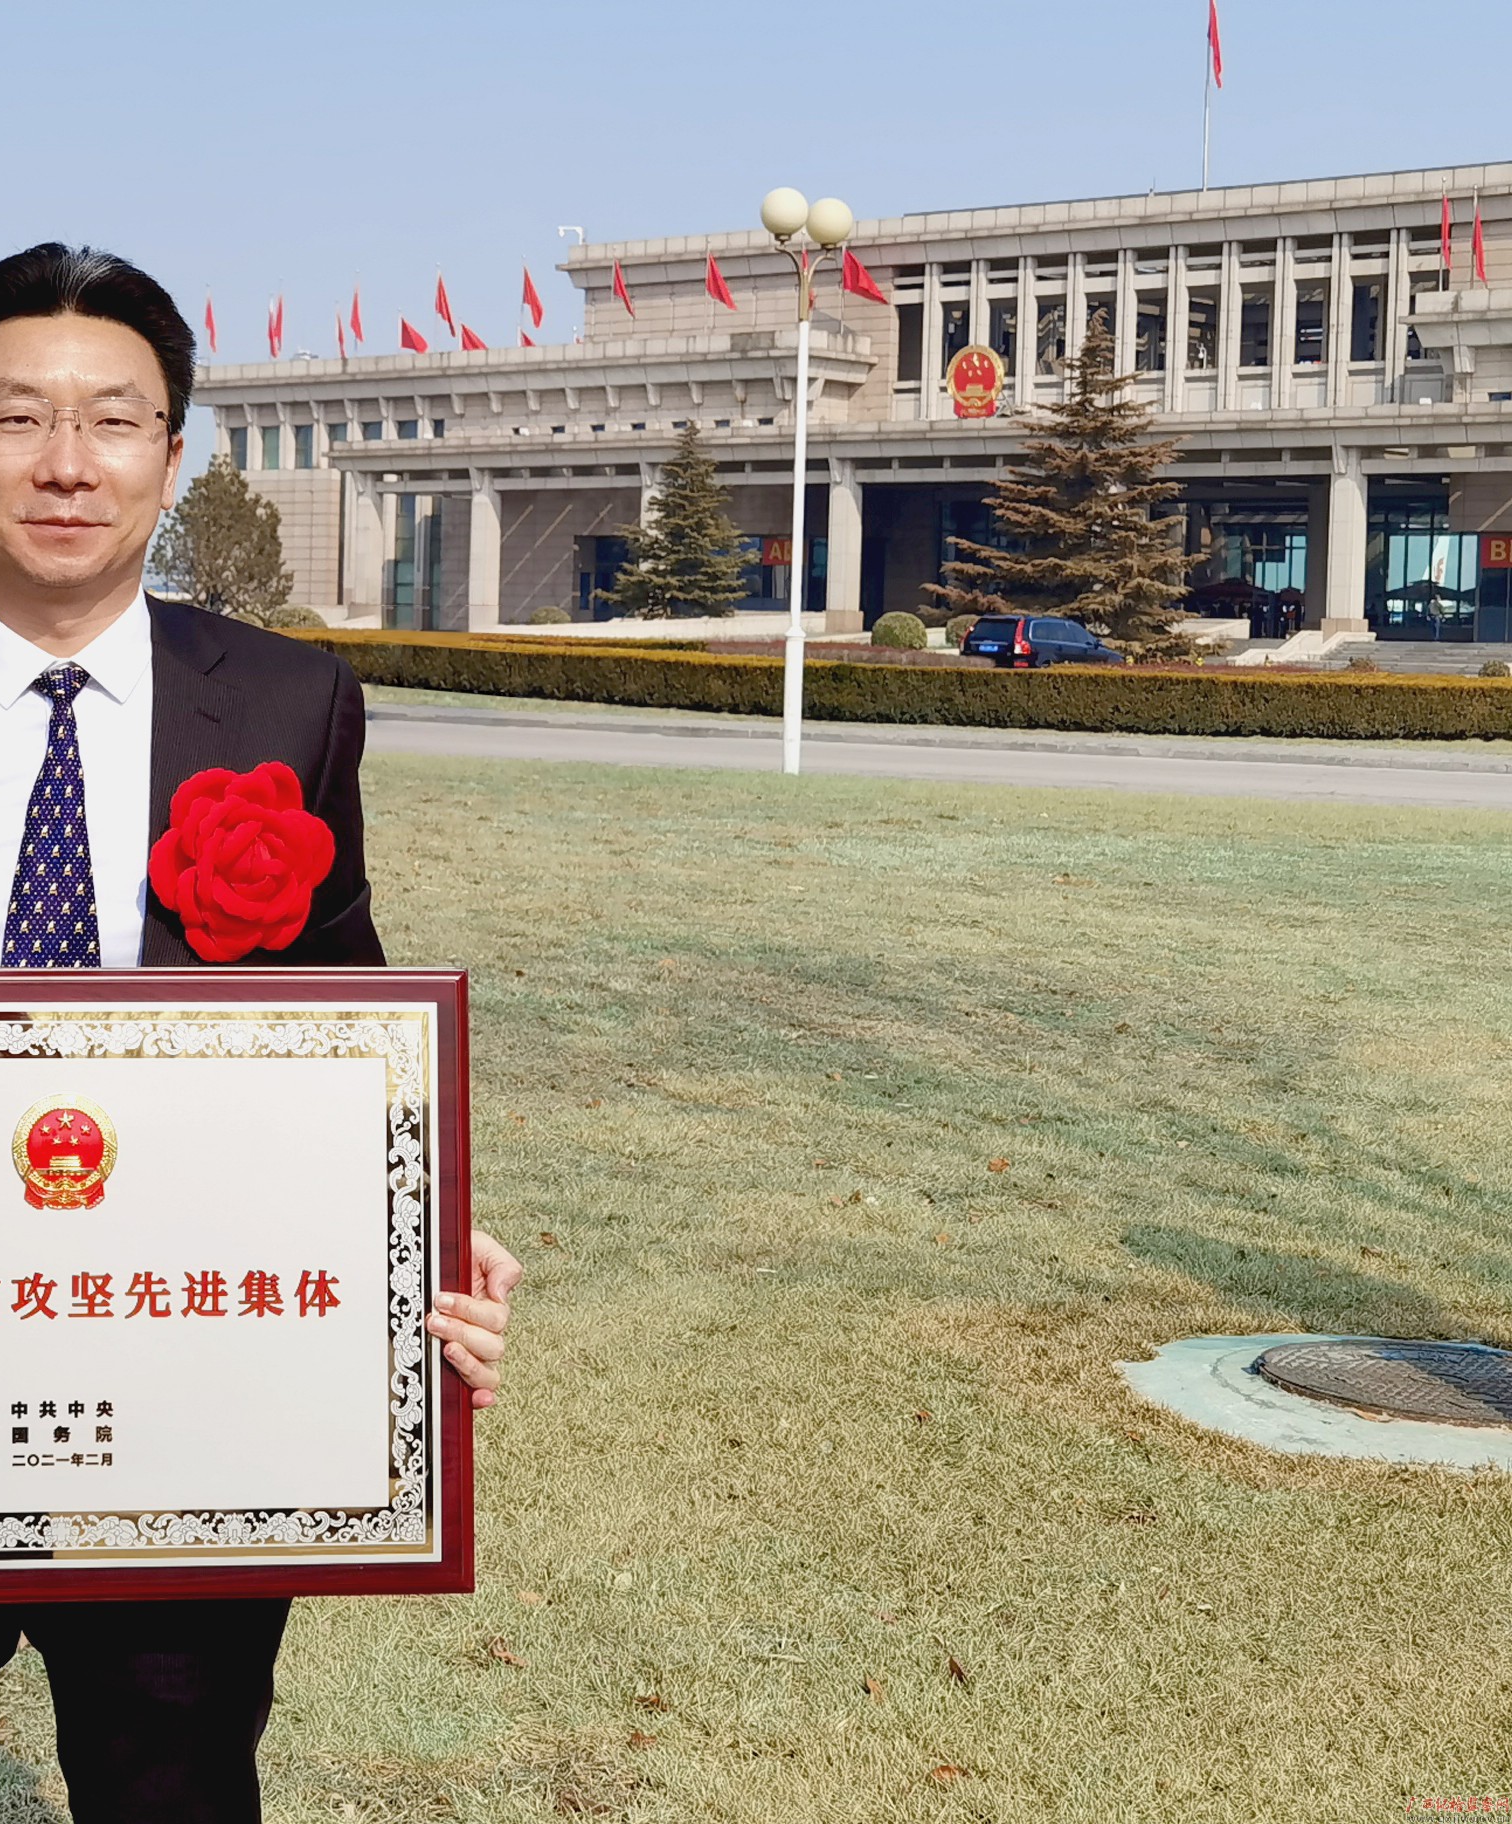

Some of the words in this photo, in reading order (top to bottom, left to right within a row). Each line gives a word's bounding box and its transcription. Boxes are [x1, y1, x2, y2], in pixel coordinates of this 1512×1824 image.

[11, 1400, 113, 1419] 中共中央
[12, 1425, 113, 1443] 国务院
